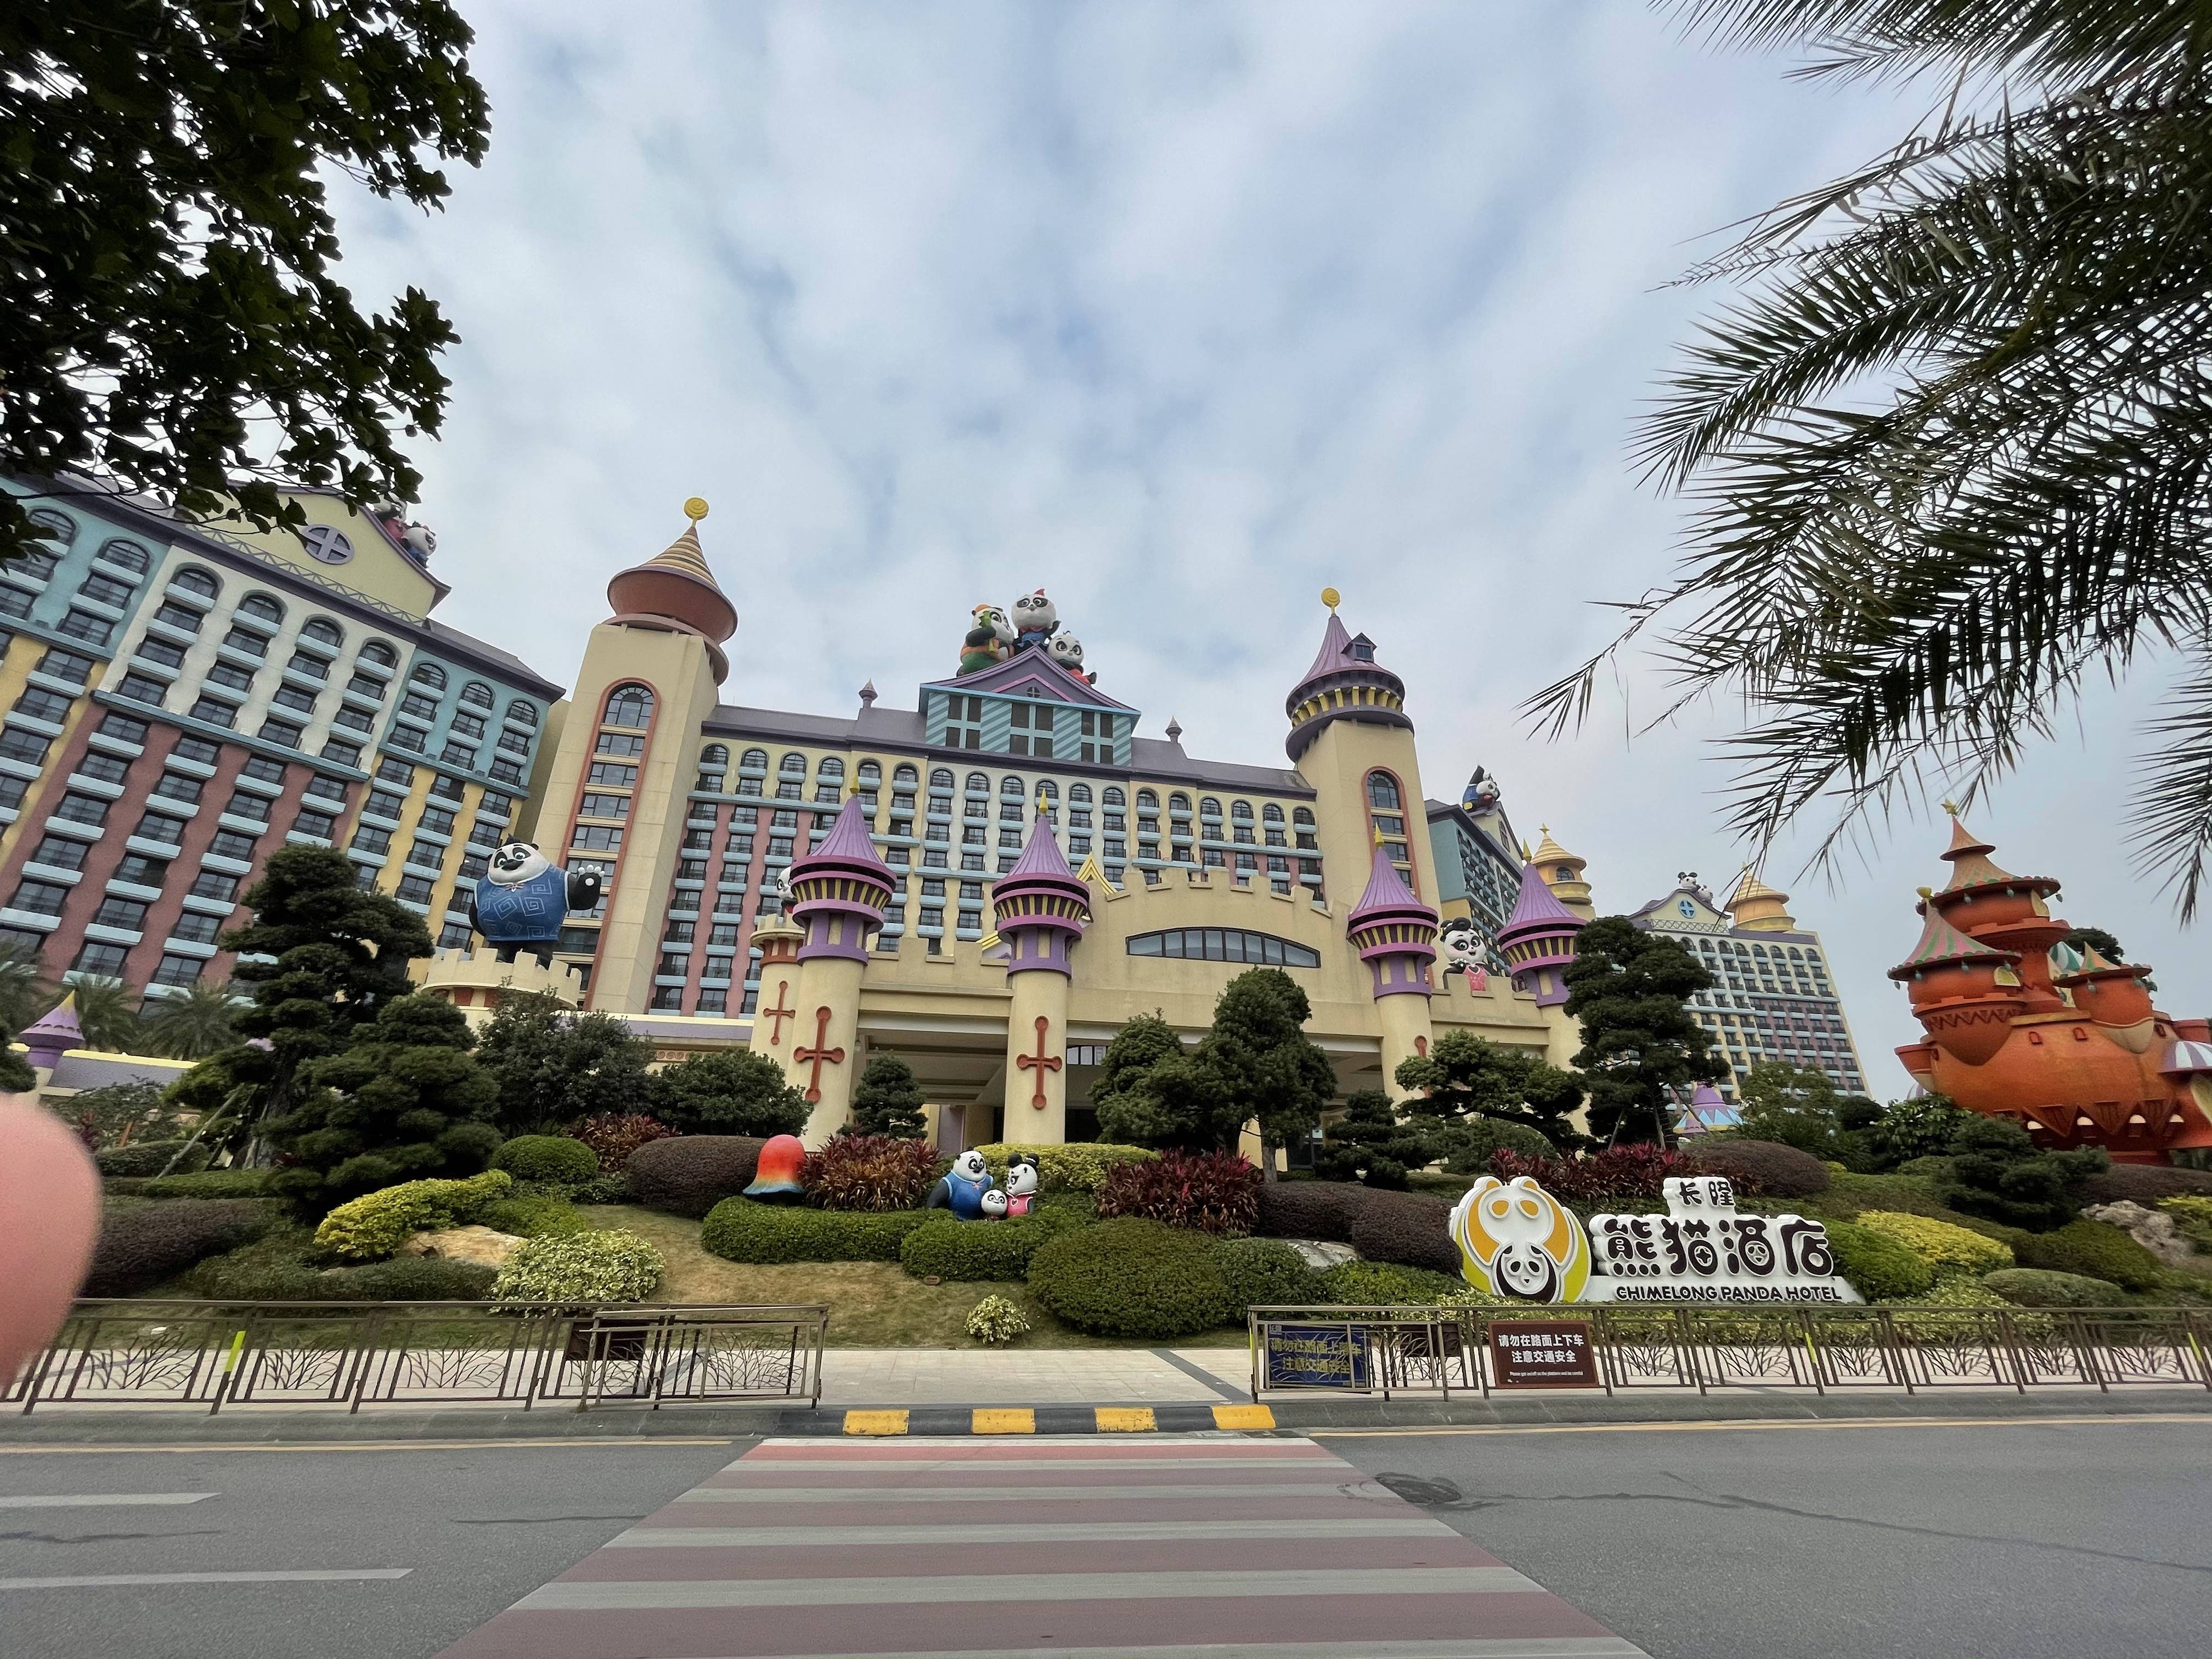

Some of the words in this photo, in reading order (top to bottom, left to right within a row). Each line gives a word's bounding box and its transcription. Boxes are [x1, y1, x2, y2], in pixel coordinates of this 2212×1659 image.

[1679, 1181, 1735, 1206] 长隆
[1604, 1219, 1832, 1276] 熊猫酒店
[1616, 1286, 1717, 1300] CHIMELONG
[1720, 1286, 1783, 1300] PANDA
[1785, 1286, 1842, 1300] HOTEL
[1498, 1334, 1584, 1347] 请勿在路面上下车
[1511, 1350, 1577, 1363] 注意交通安全
